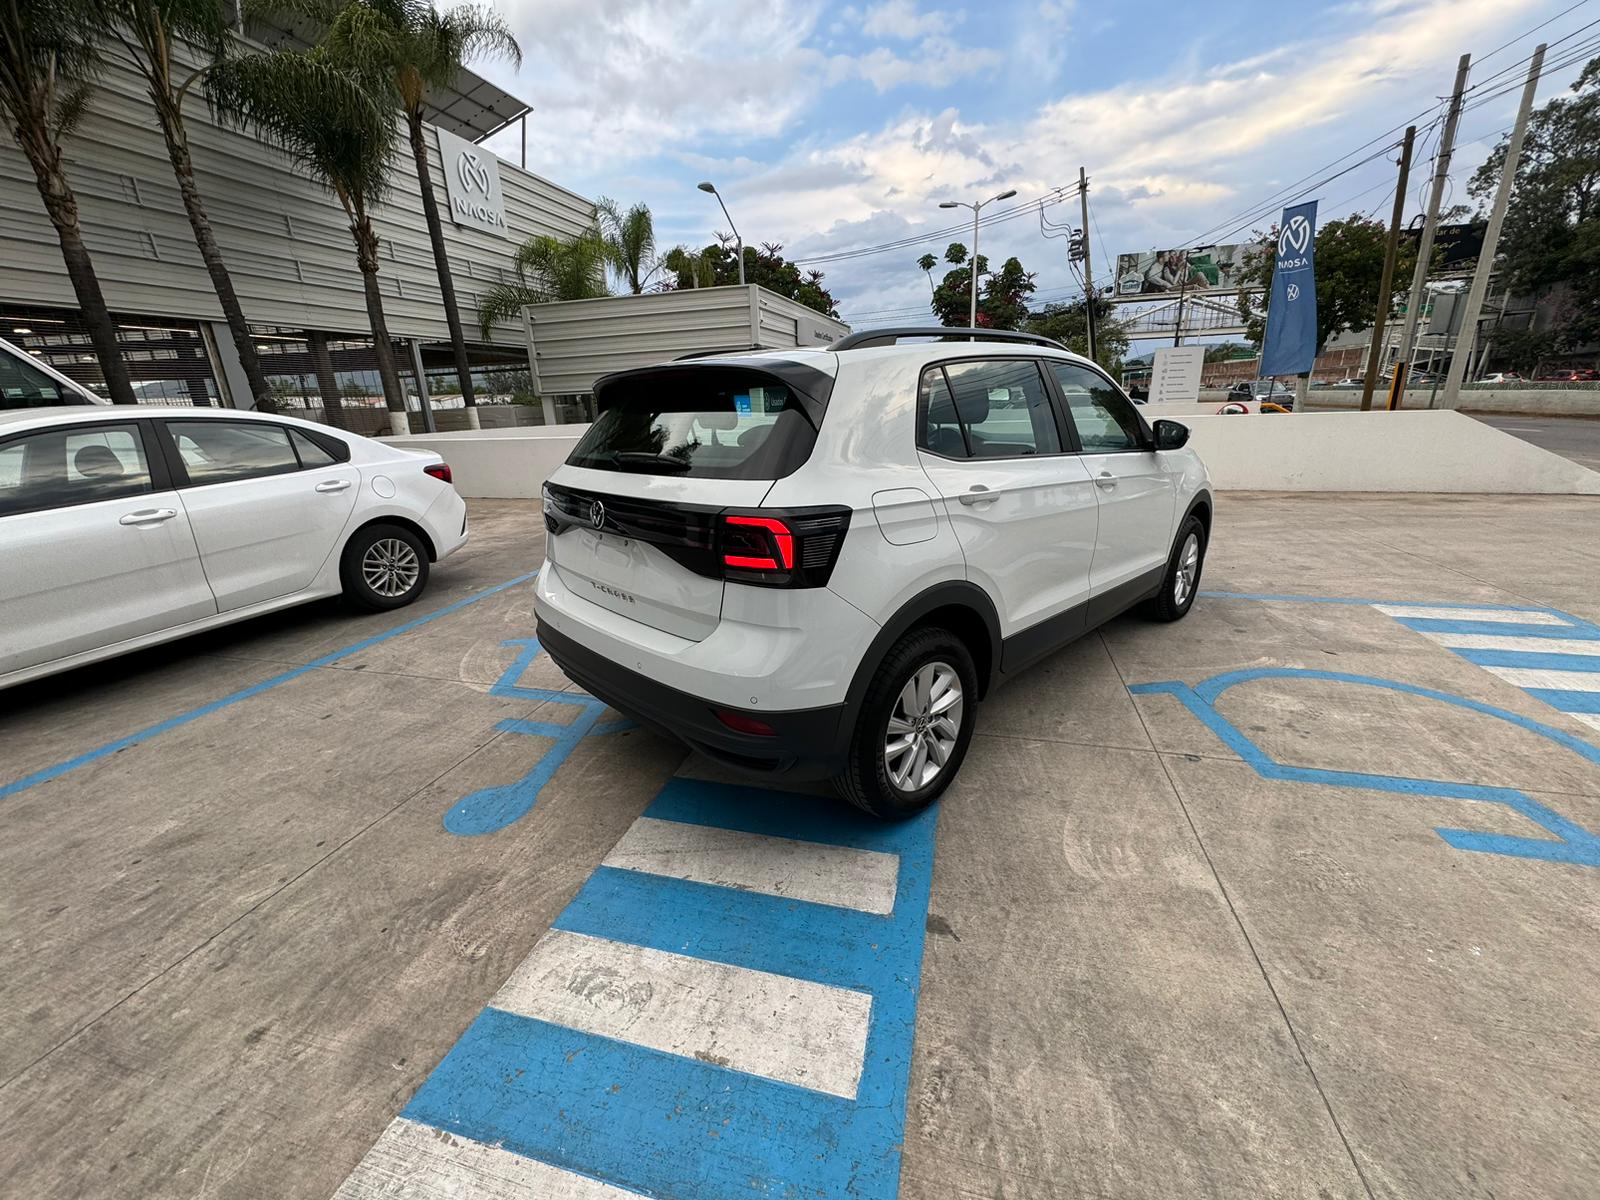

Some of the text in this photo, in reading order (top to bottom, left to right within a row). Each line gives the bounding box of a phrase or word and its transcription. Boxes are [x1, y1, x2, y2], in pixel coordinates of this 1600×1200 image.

[454, 197, 505, 228] NAOSA
[1436, 228, 1448, 236] tar
[1278, 257, 1308, 269] NAOSA
[590, 581, 636, 604] T-CROSS
